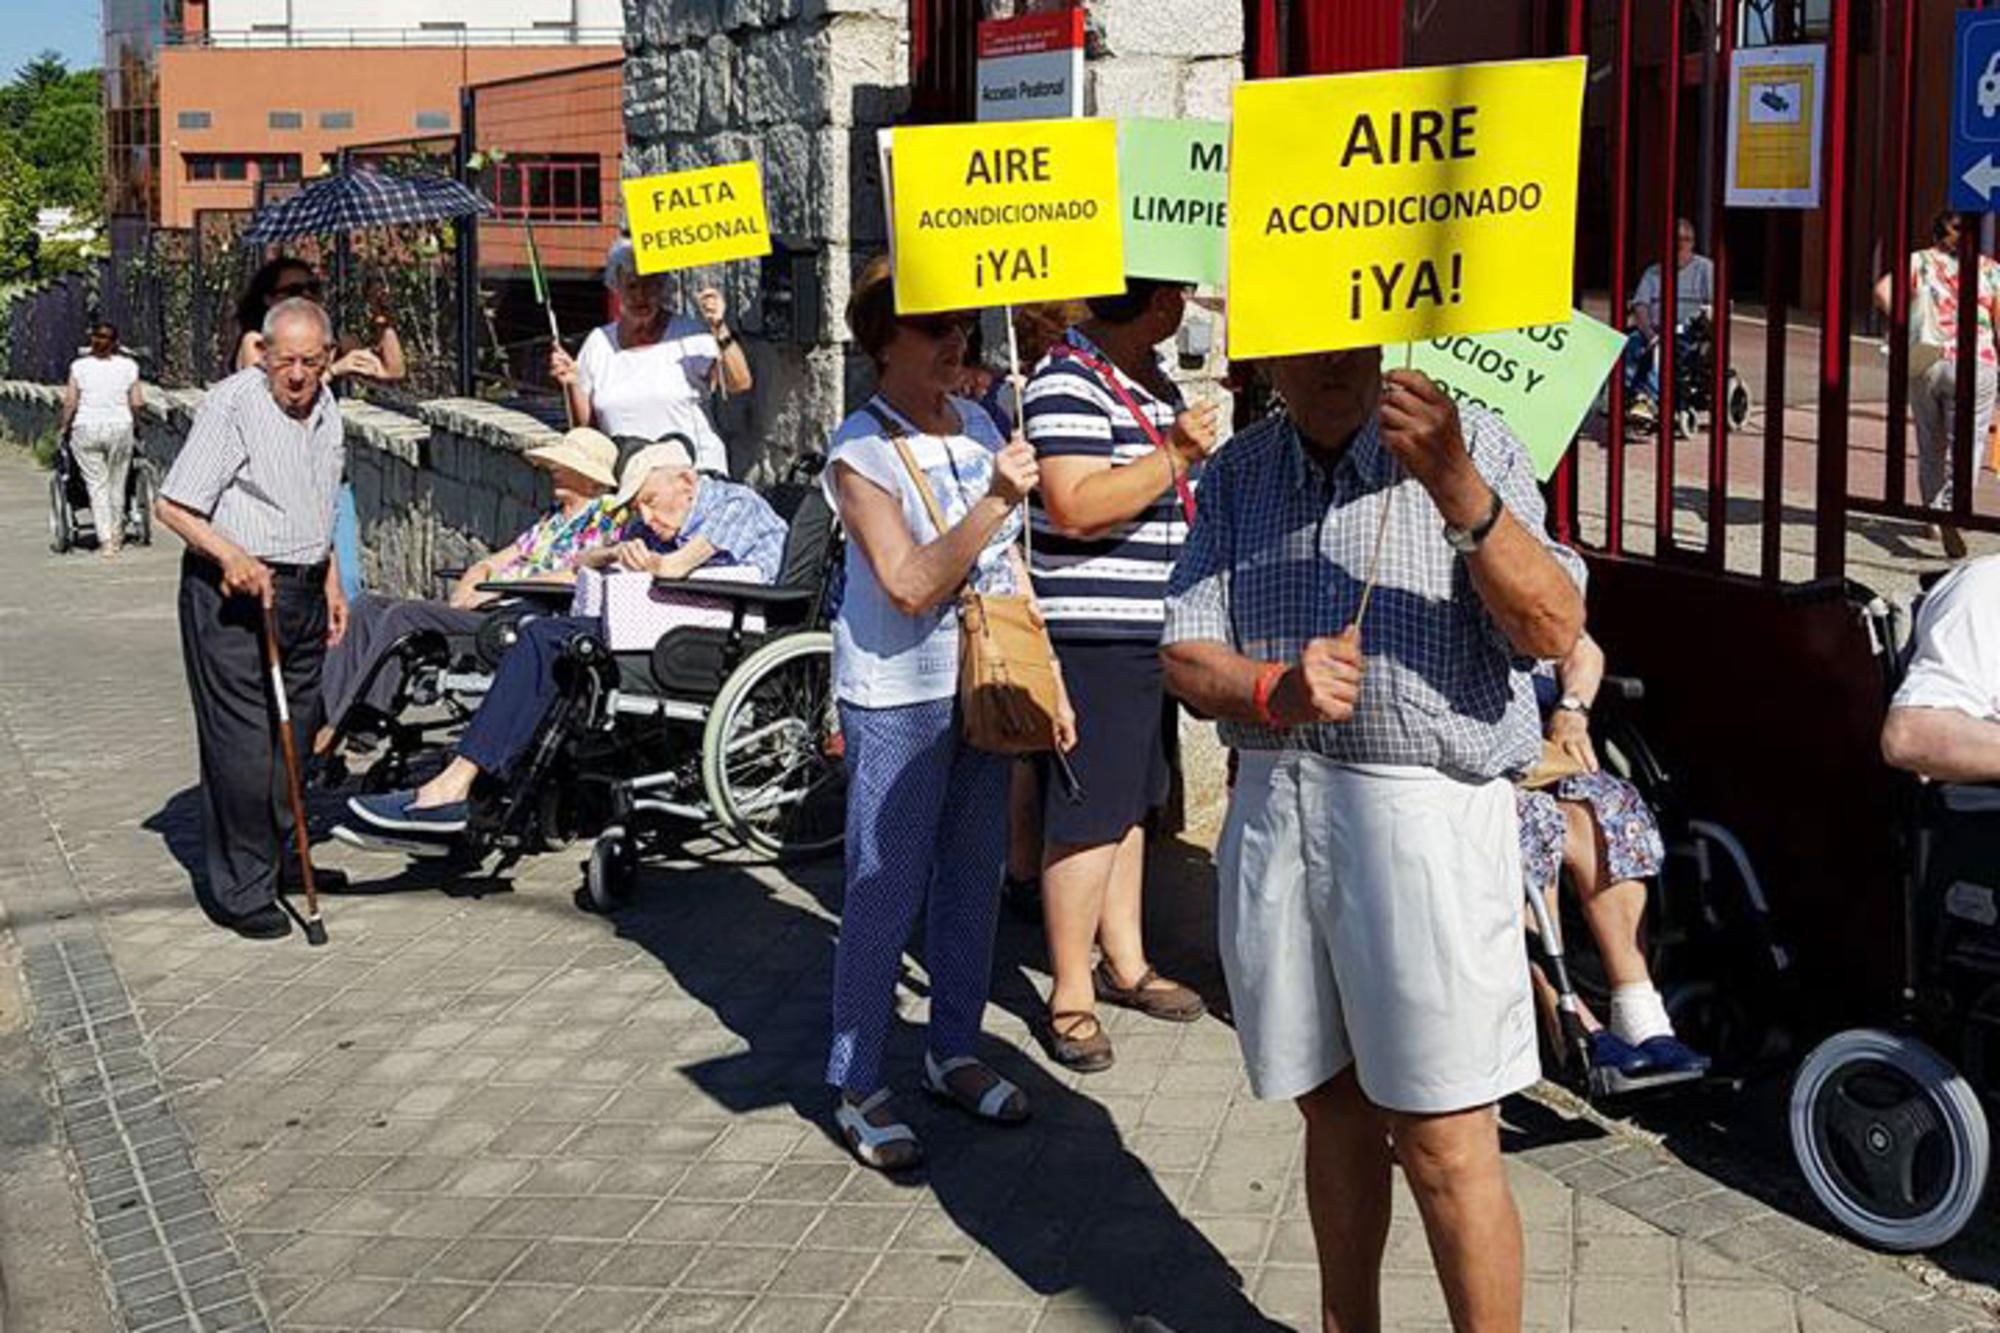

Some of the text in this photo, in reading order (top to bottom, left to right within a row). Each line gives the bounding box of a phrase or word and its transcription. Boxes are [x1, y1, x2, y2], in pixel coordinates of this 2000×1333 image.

[1340, 105, 1477, 168] AIRE
[965, 146, 1050, 186] AIRE
[1190, 141, 1229, 172] M
[652, 180, 735, 212] FALTA
[918, 199, 1098, 229] ACONDICIONADO
[1265, 183, 1542, 236] ACONDICIONADO
[640, 215, 761, 251] PERSONAL
[975, 244, 1048, 288] ¡YA!
[1351, 253, 1463, 321] ¡YA!
[1523, 368, 1545, 394] Y
